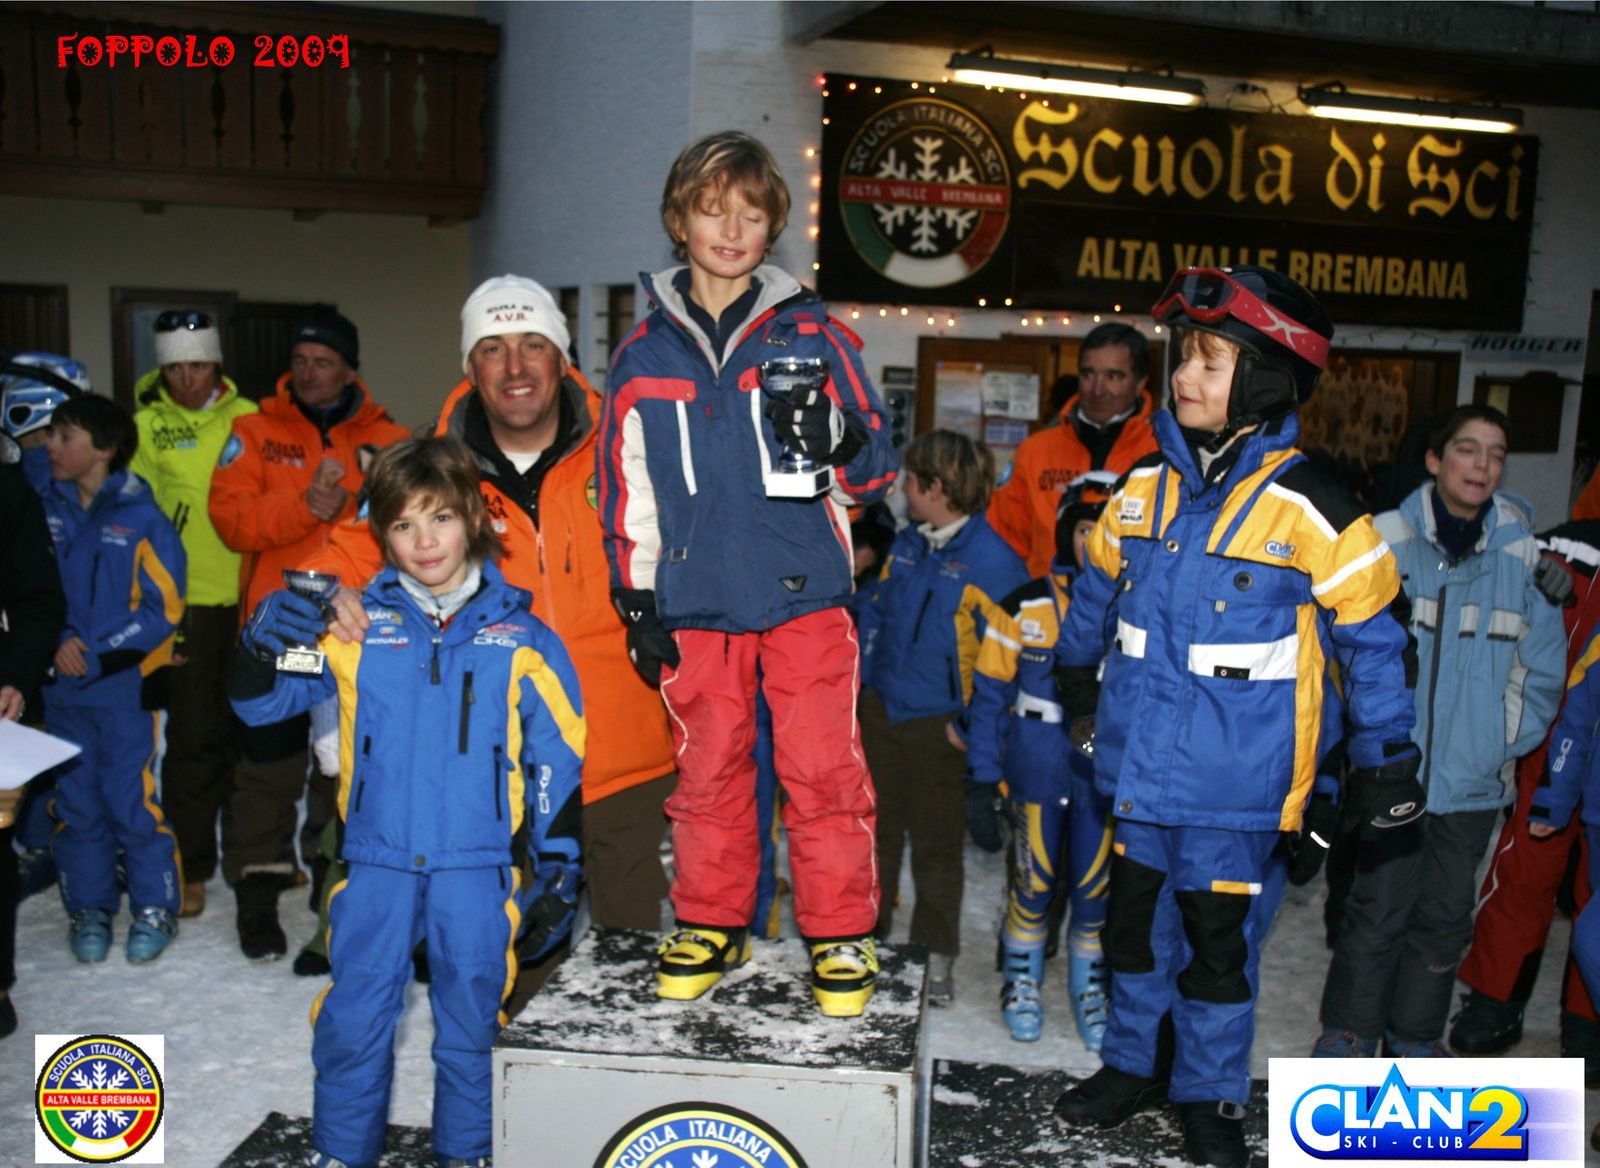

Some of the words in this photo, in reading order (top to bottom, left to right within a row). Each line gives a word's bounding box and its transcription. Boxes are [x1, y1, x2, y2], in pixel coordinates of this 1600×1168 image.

[914, 105, 984, 147] ITALIANA
[1013, 99, 1294, 206] Scuola
[1326, 126, 1388, 213] di
[1407, 133, 1525, 221] Sci
[1076, 236, 1163, 283] ALTA
[1288, 250, 1468, 299] BREMBANA
[614, 1124, 679, 1168] CUOLA
[688, 1119, 773, 1165] ITALIANA
